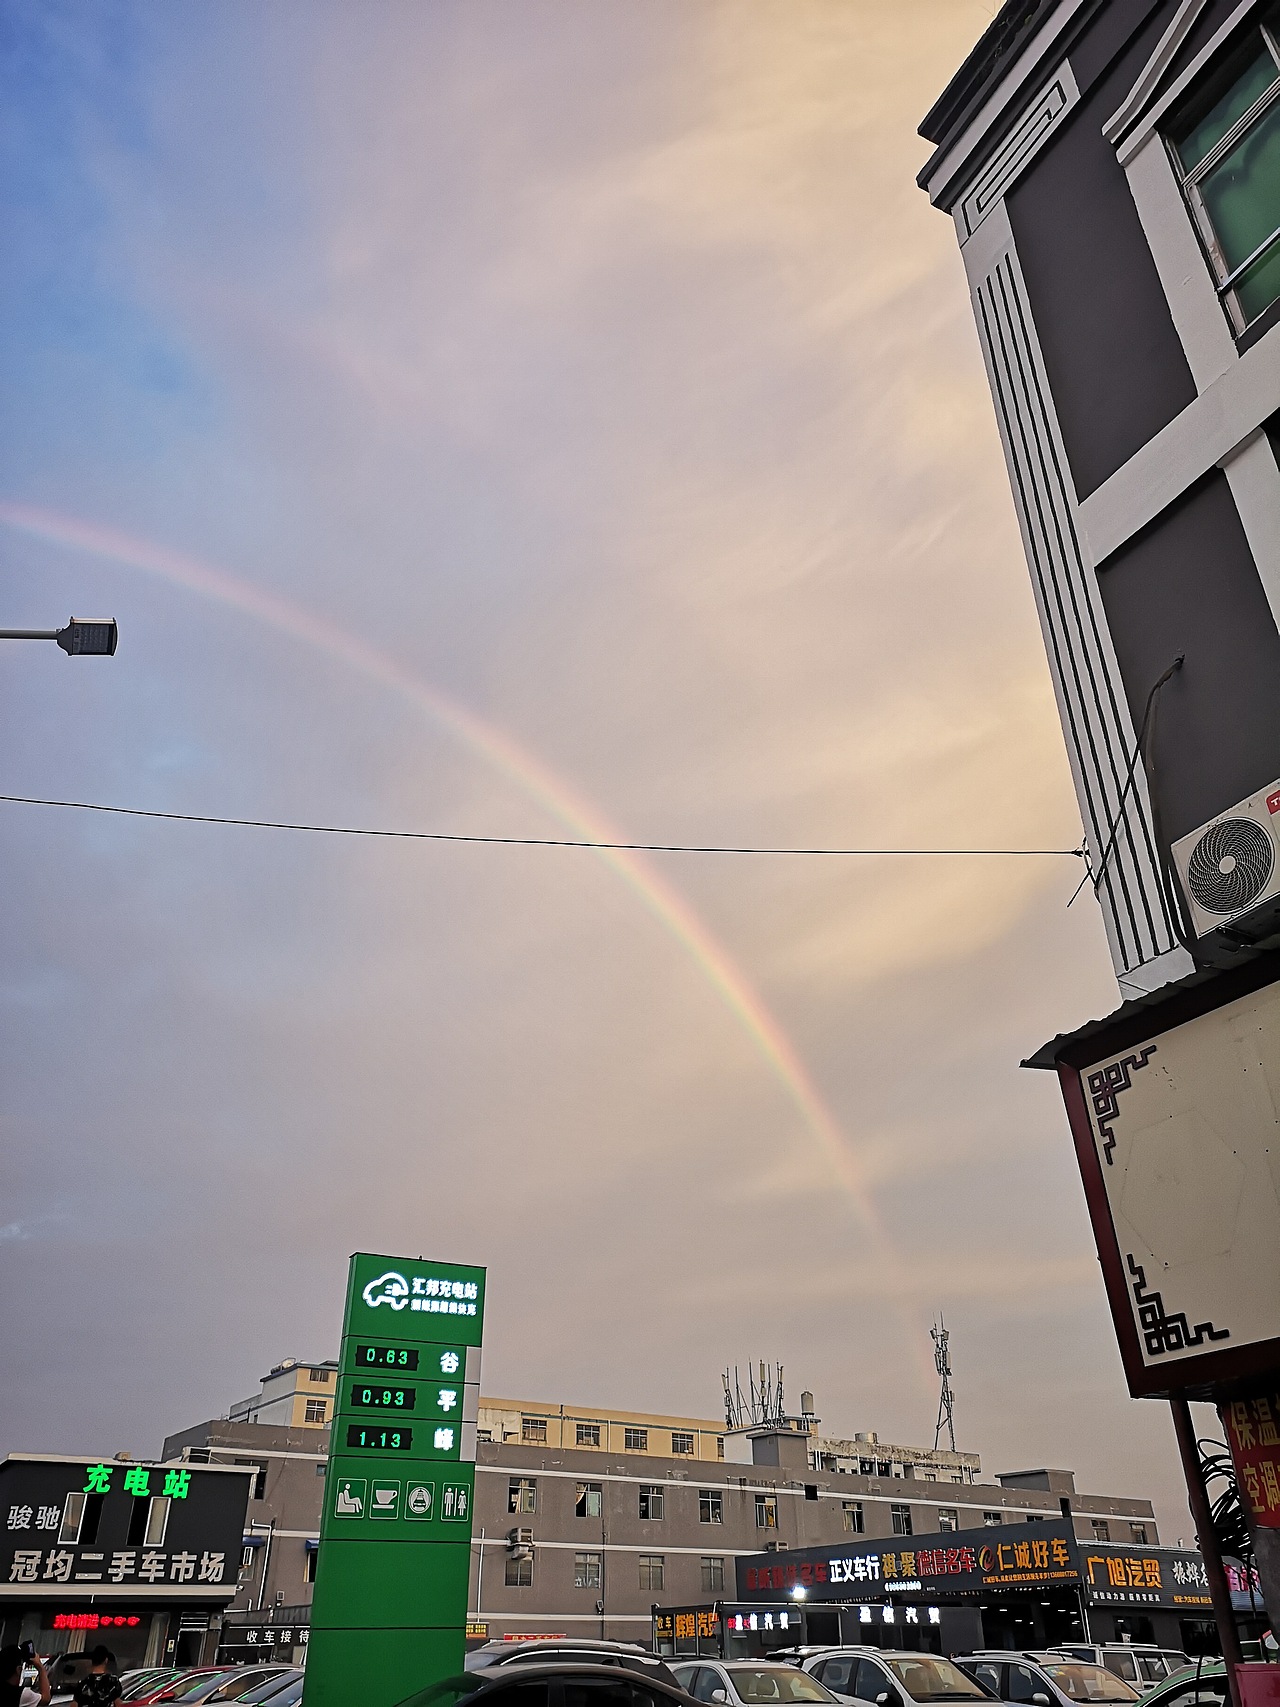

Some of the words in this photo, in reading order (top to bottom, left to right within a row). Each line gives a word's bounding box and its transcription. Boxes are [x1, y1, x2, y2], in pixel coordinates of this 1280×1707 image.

[411, 1277, 478, 1300] 汇邦充电站
[366, 1348, 408, 1365] 0.63
[440, 1351, 459, 1374] 谷
[362, 1389, 405, 1406] 0.93
[437, 1389, 457, 1412] 平
[1230, 1393, 1280, 1451] 保温
[359, 1431, 401, 1448] 1.13
[433, 1427, 454, 1451] 峰
[83, 1464, 191, 1499] 充电站
[1242, 1461, 1280, 1513] 空调
[7, 1504, 61, 1530] 骏驰
[8, 1549, 226, 1583] 冠均二手车市场
[882, 1551, 917, 1579] 祺聚
[916, 1546, 977, 1577] 德信名车
[996, 1537, 1071, 1572] 仁诚好车
[829, 1555, 880, 1583] 正义车行
[1087, 1555, 1163, 1589] 广旭汽贸
[53, 1613, 99, 1629] 充电请进
[246, 1629, 310, 1644] 收车接待
